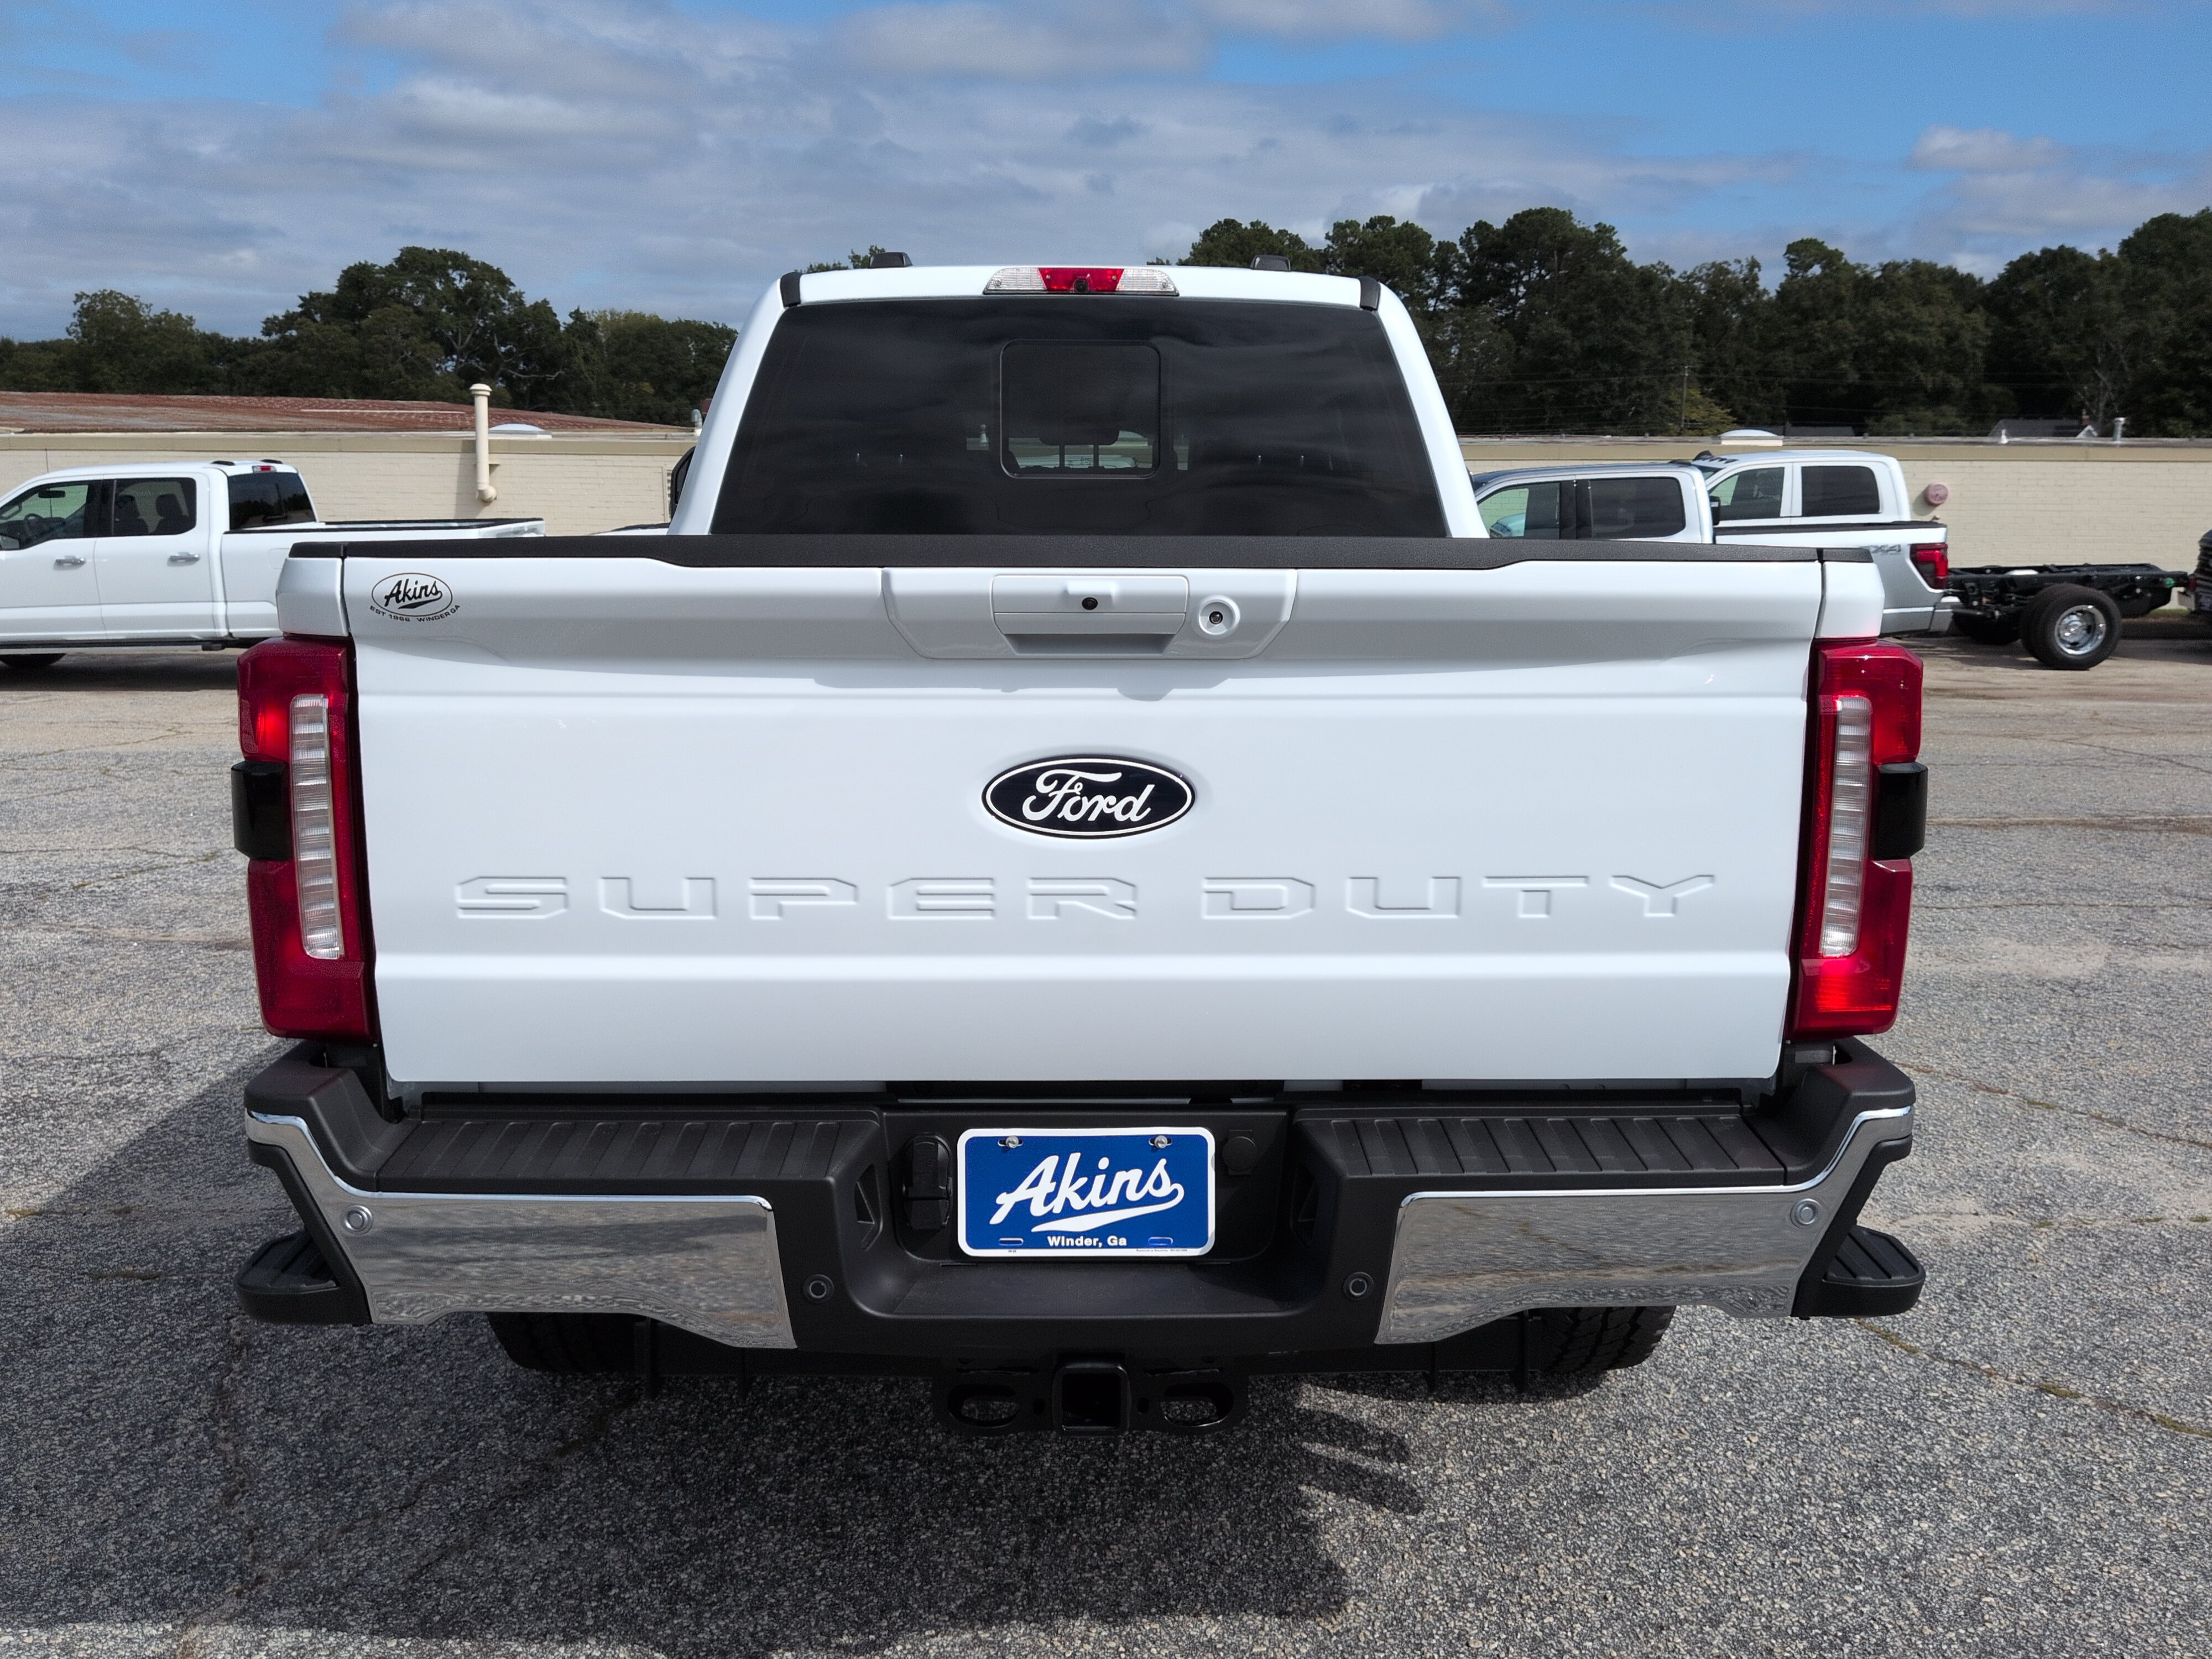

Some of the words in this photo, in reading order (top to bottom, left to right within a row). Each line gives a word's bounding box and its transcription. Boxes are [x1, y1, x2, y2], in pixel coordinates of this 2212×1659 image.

[370, 606, 386, 616] EST
[416, 612, 451, 622] WINDER
[451, 604, 460, 614] GA
[384, 578, 442, 609] Akins
[1022, 769, 1155, 821] Ford
[455, 876, 1137, 924] SUPER
[1201, 875, 1717, 920] DUTY
[989, 1152, 1185, 1233] Akins
[1107, 1235, 1127, 1246] Ga
